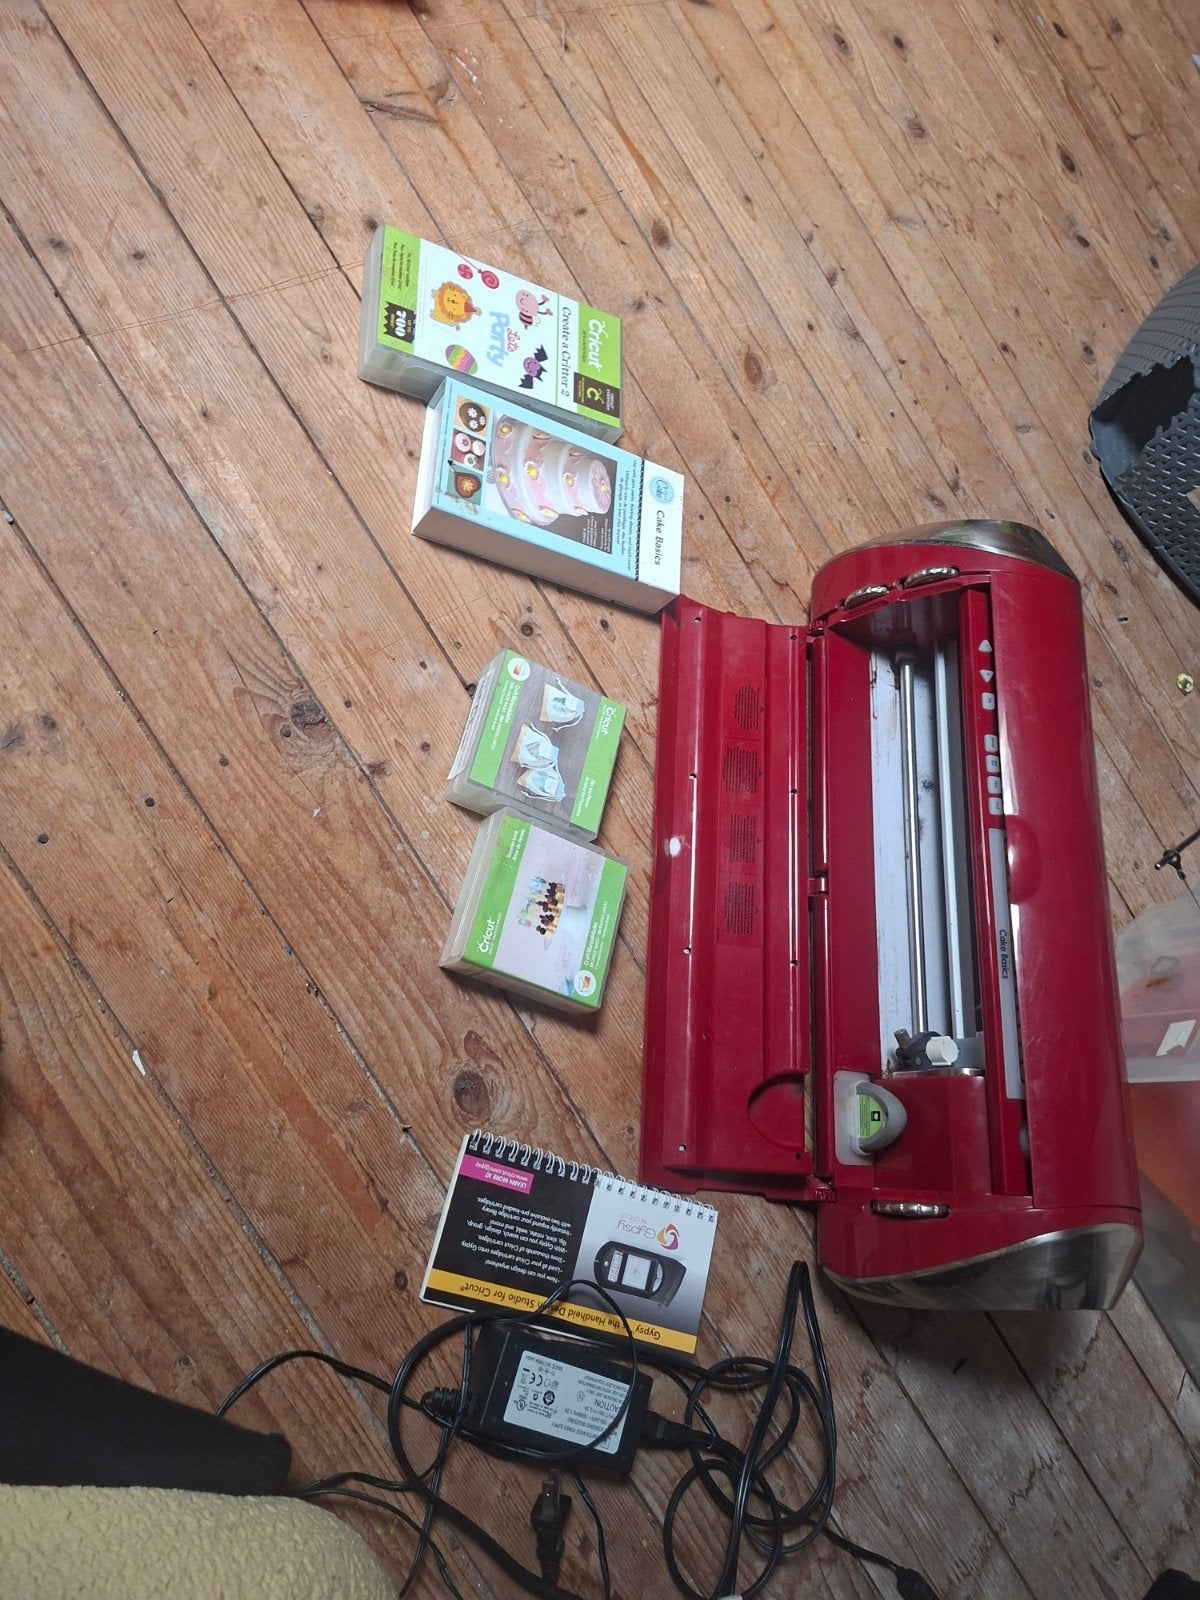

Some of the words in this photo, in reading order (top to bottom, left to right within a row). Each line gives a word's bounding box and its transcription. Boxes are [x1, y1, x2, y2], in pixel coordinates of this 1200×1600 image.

[394, 309, 407, 337] 700
[561, 306, 571, 341] Create
[486, 310, 510, 367] Party
[505, 327, 521, 352] Let's
[587, 318, 609, 369] Cricut
[561, 350, 571, 388] Critter
[560, 388, 570, 397] 2
[655, 509, 665, 533] Cake
[653, 535, 664, 565] Basics
[600, 706, 617, 736] Cricut
[475, 918, 495, 953] Cricut
[998, 928, 1008, 952] Cake
[1000, 953, 1010, 979] Basics
[491, 1173, 509, 1183] MORE
[508, 1178, 527, 1188] LEARN
[481, 1204, 498, 1216] library
[497, 1209, 520, 1221] cartridge
[501, 1203, 530, 1216] pre-loaded
[529, 1211, 551, 1222] exclusive
[550, 1217, 560, 1225] two
[530, 1219, 550, 1229] expand
[549, 1224, 570, 1236] Instantly
[615, 1218, 656, 1240] Gypsy
[477, 1245, 490, 1253] onto
[503, 1241, 519, 1252] Cricut
[537, 1239, 554, 1250] Gypsy
[553, 1245, 565, 1253] With
[489, 1248, 515, 1260] cartridges
[524, 1247, 550, 1259] thousands
[549, 1254, 563, 1263] Store
[514, 1255, 530, 1265] Cricut
[509, 1264, 527, 1275] design
[547, 1264, 561, 1273] Load
[459, 1281, 491, 1297] Cricut®
[492, 1289, 506, 1302] for
[507, 1293, 535, 1308] Studio
[566, 1308, 606, 1326] Handheld
[607, 1317, 620, 1330] the
